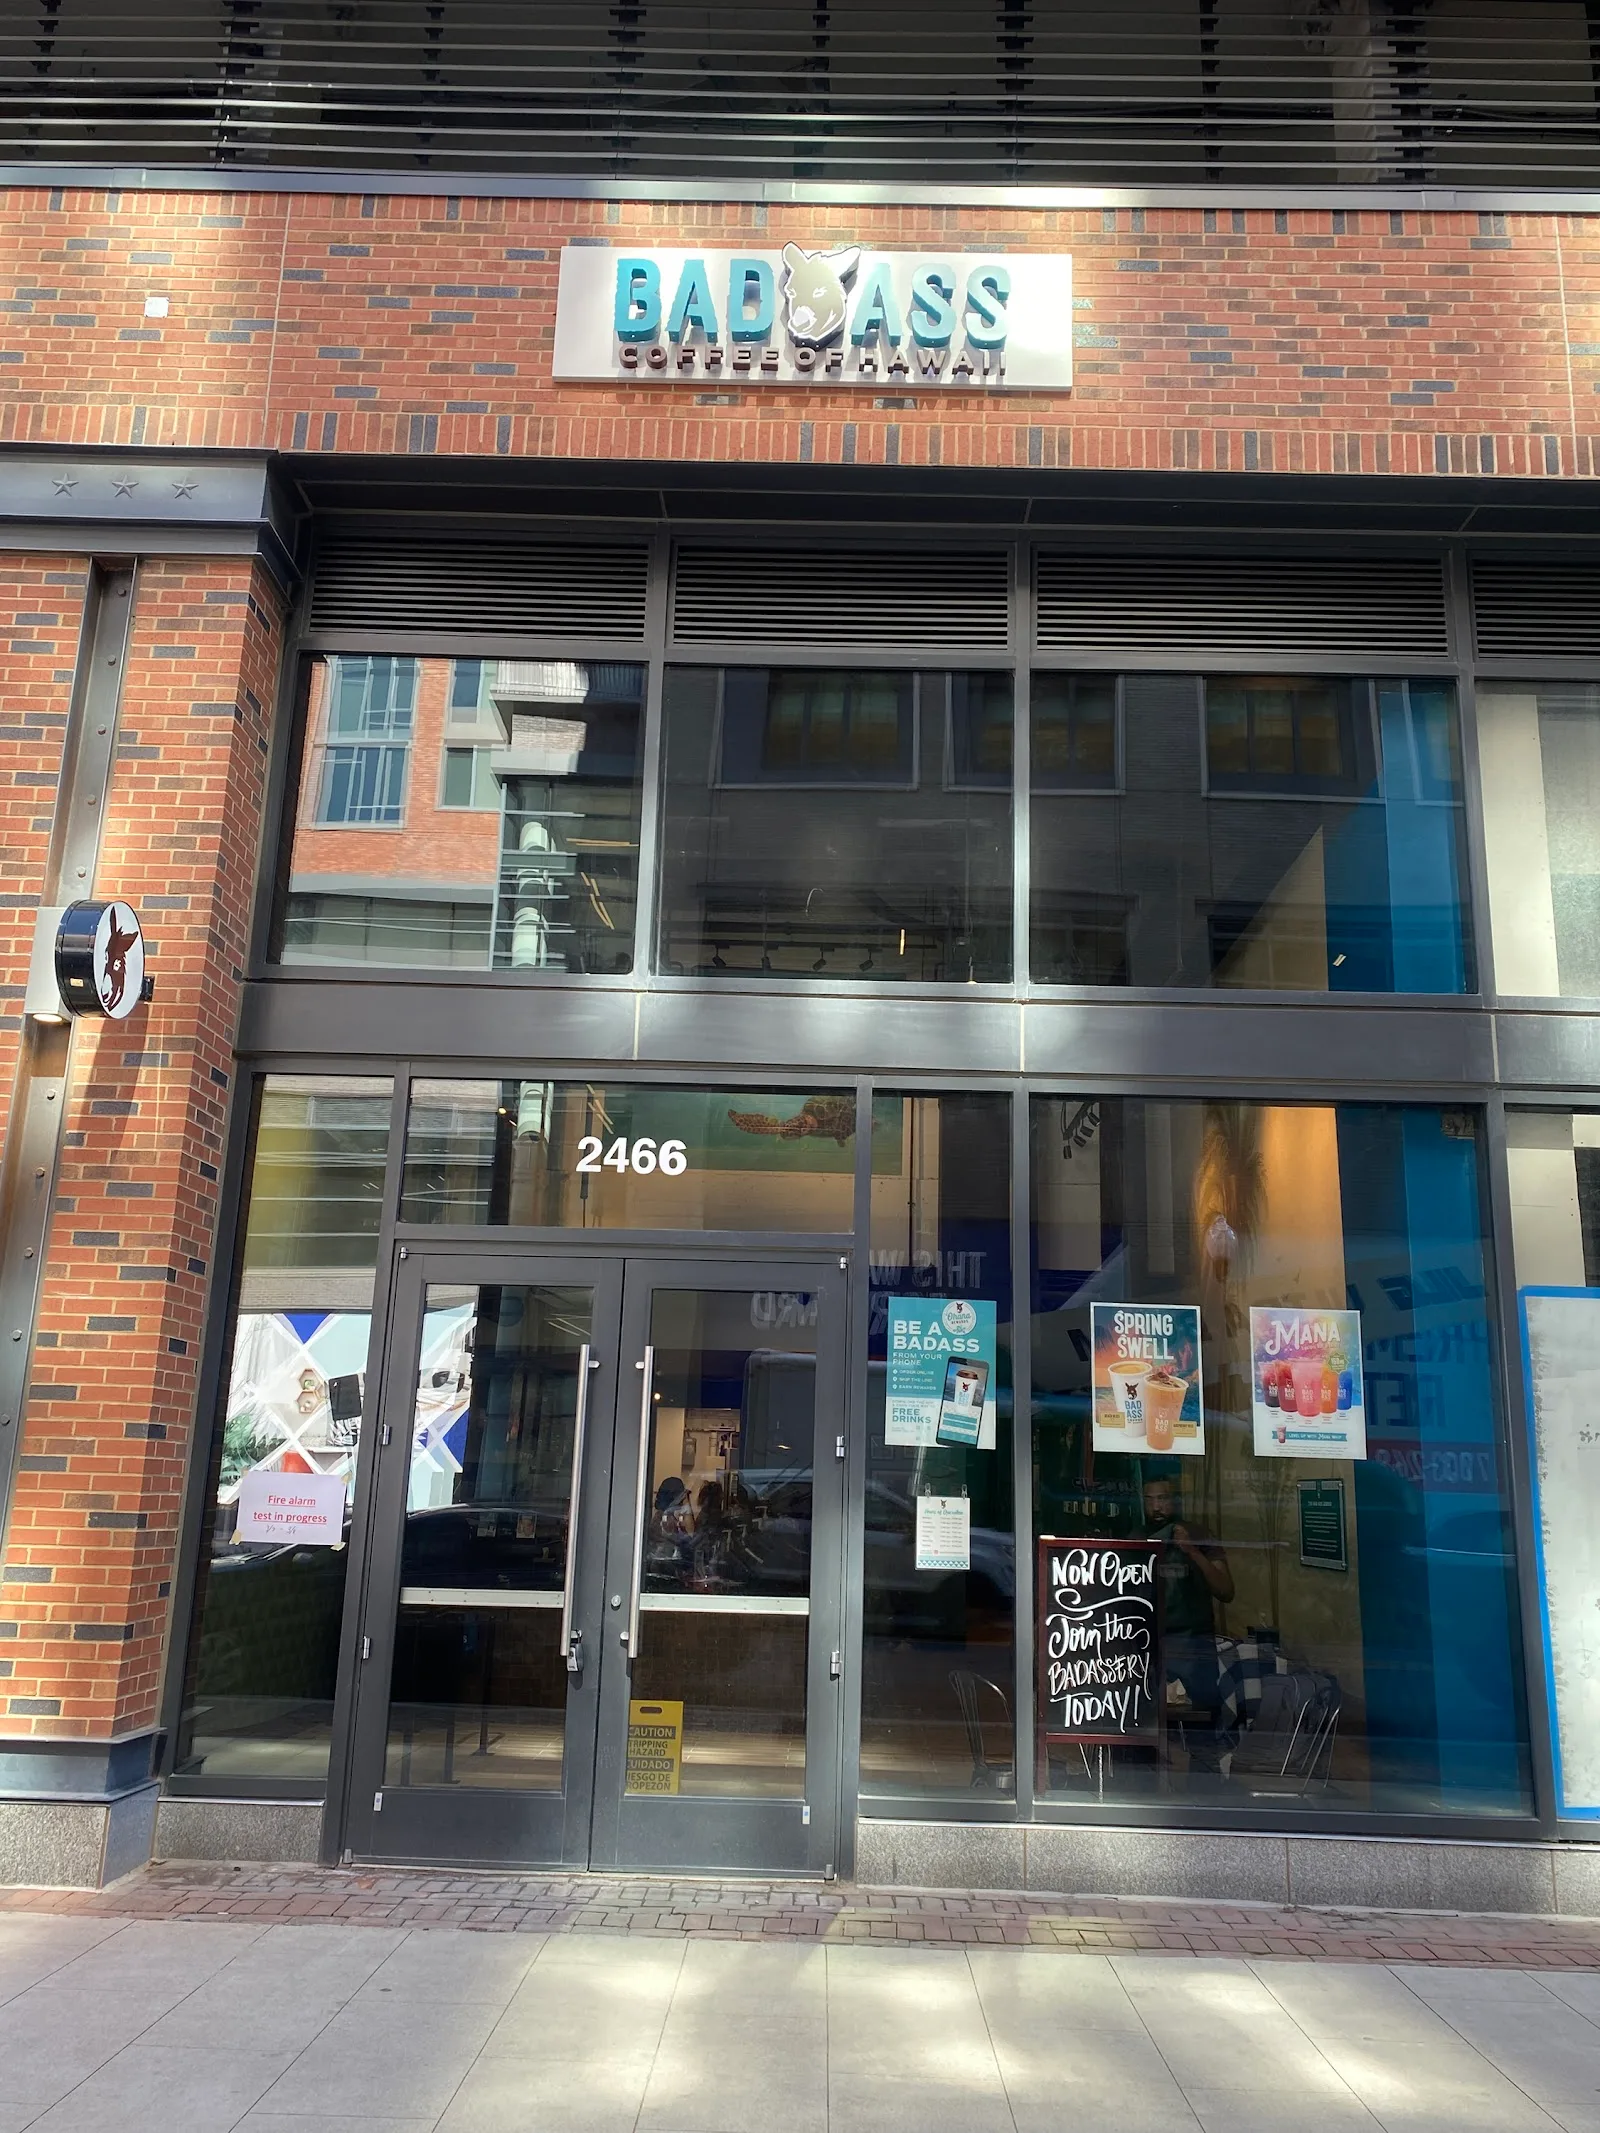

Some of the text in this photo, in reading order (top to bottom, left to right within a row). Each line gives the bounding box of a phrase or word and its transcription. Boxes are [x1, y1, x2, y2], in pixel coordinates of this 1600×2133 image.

[614, 258, 1011, 349] BAD ASS
[619, 345, 1007, 376] COFFEE OF HAWAII
[576, 1136, 687, 1175] 2466
[894, 1320, 942, 1335] BE A
[1114, 1310, 1173, 1336] SPRING
[894, 1336, 980, 1352] BADASS
[1117, 1334, 1174, 1360] SWELL
[1125, 1400, 1142, 1410] BAD
[892, 1408, 920, 1416] FREE
[1126, 1410, 1142, 1418] ASS
[892, 1416, 932, 1424] DRINKS
[268, 1495, 316, 1506] Fire alarm
[254, 1512, 327, 1524] test in progress
[1046, 1610, 1150, 1659] Join the
[1048, 1652, 1151, 1700] BADASSERY
[1050, 1685, 1140, 1733] TODAY!
[629, 1740, 668, 1748] TRIPPING
[629, 1748, 666, 1756] HAZARD
[628, 1760, 670, 1769] UIDADO
[628, 1772, 670, 1782] IESGO DE
